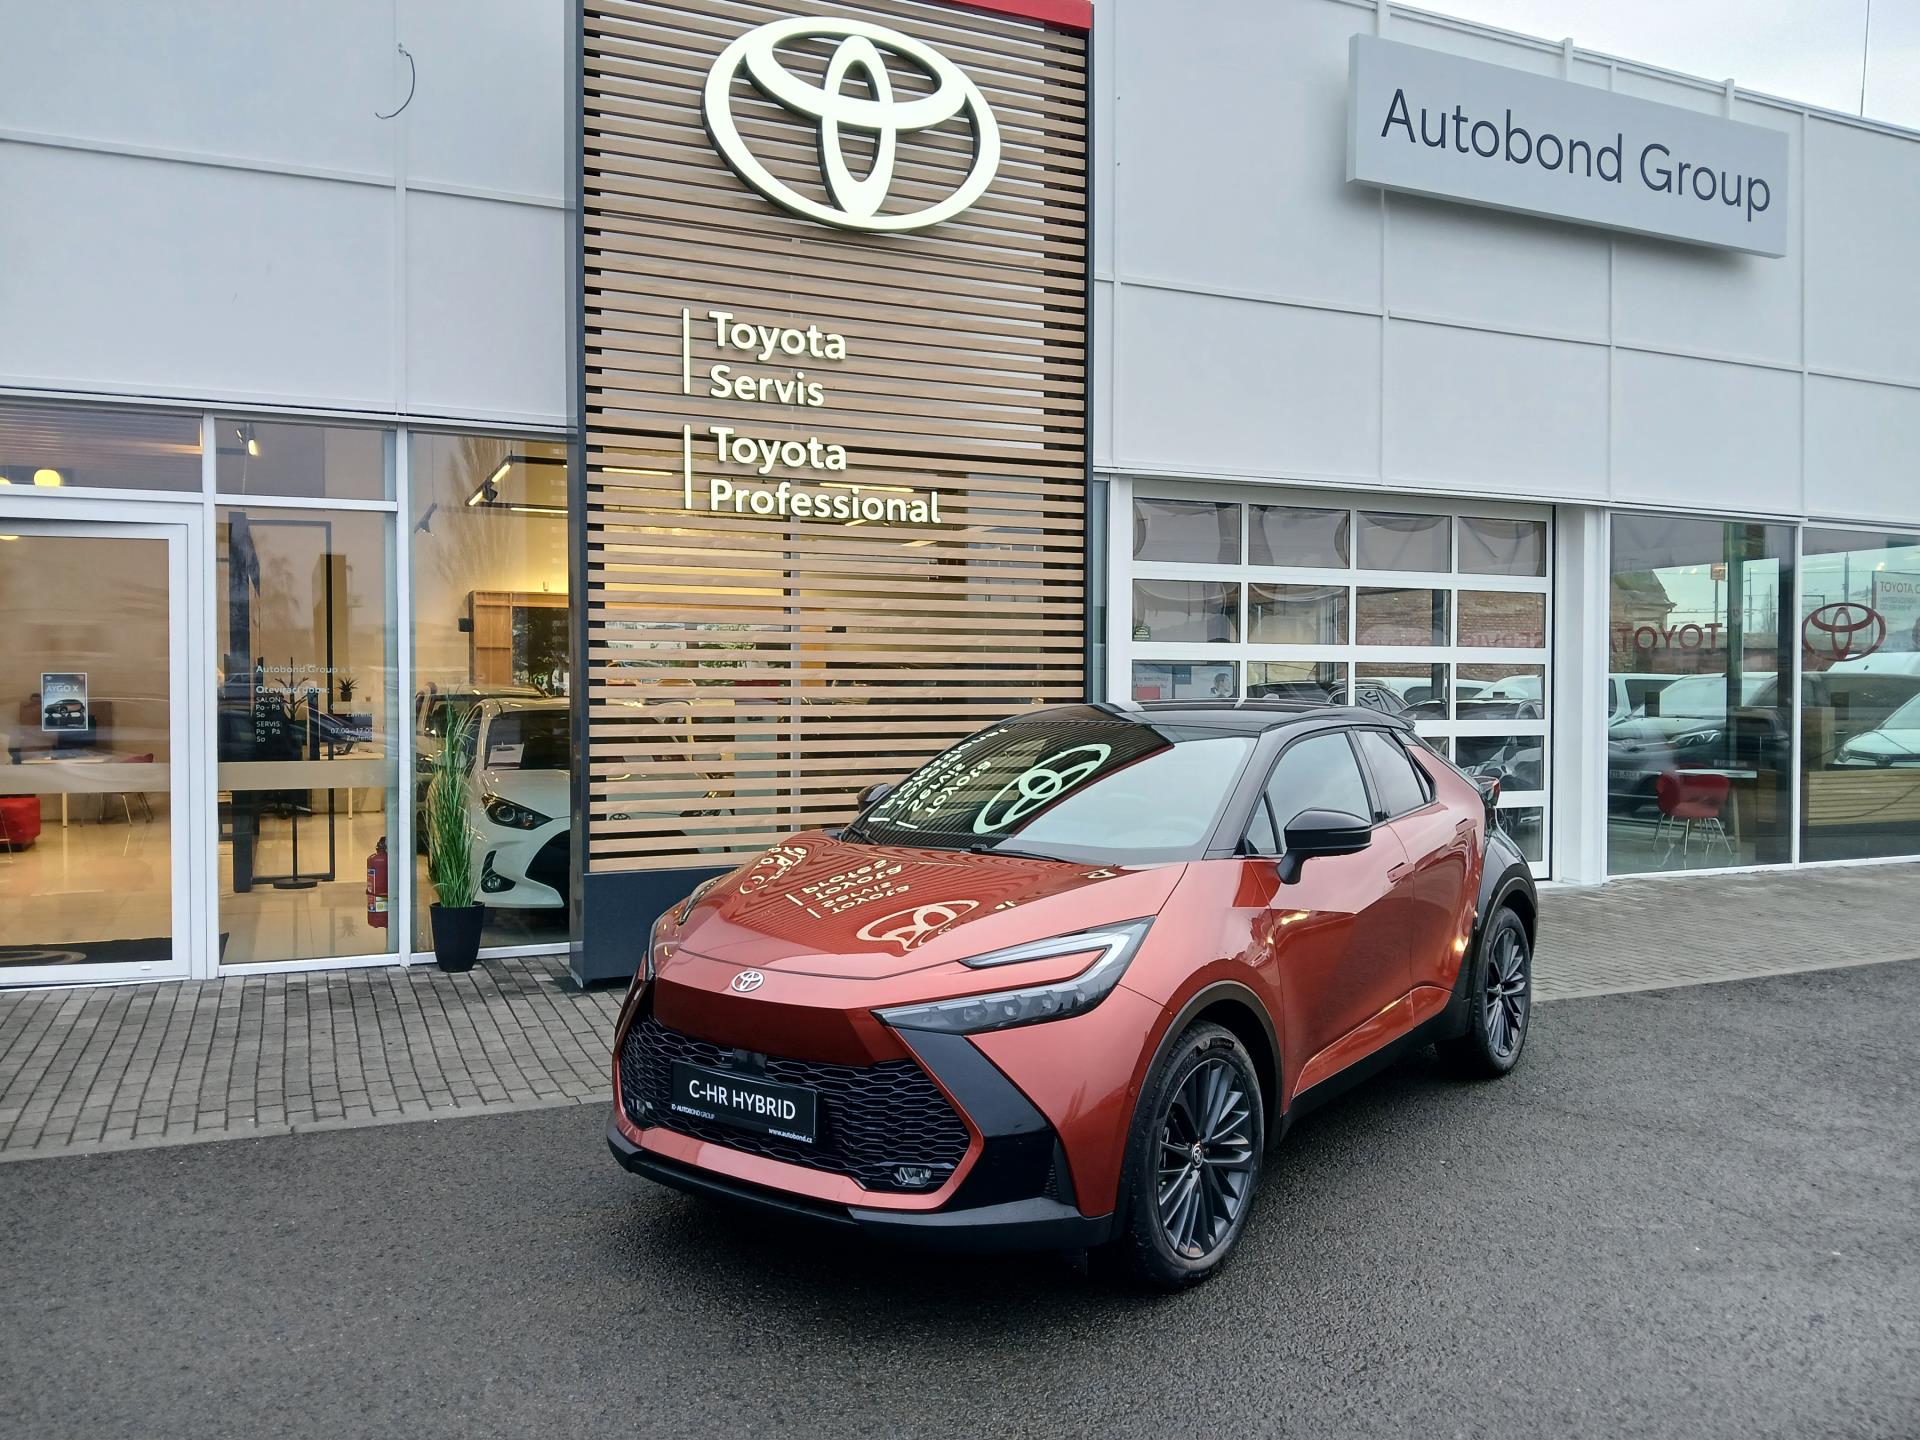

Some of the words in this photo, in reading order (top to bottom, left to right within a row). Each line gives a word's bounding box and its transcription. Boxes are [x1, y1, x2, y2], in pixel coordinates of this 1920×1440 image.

[1381, 87, 1623, 184] Autobond
[1639, 143, 1771, 223] Group
[708, 310, 846, 361] Toyota
[709, 364, 825, 407] Servis
[709, 426, 847, 475] Toyota
[709, 478, 942, 524] Professional
[256, 665, 305, 673] Autobond
[307, 665, 338, 675] Group
[688, 1079, 729, 1106] C-HR
[732, 1089, 796, 1120] HYBRID
